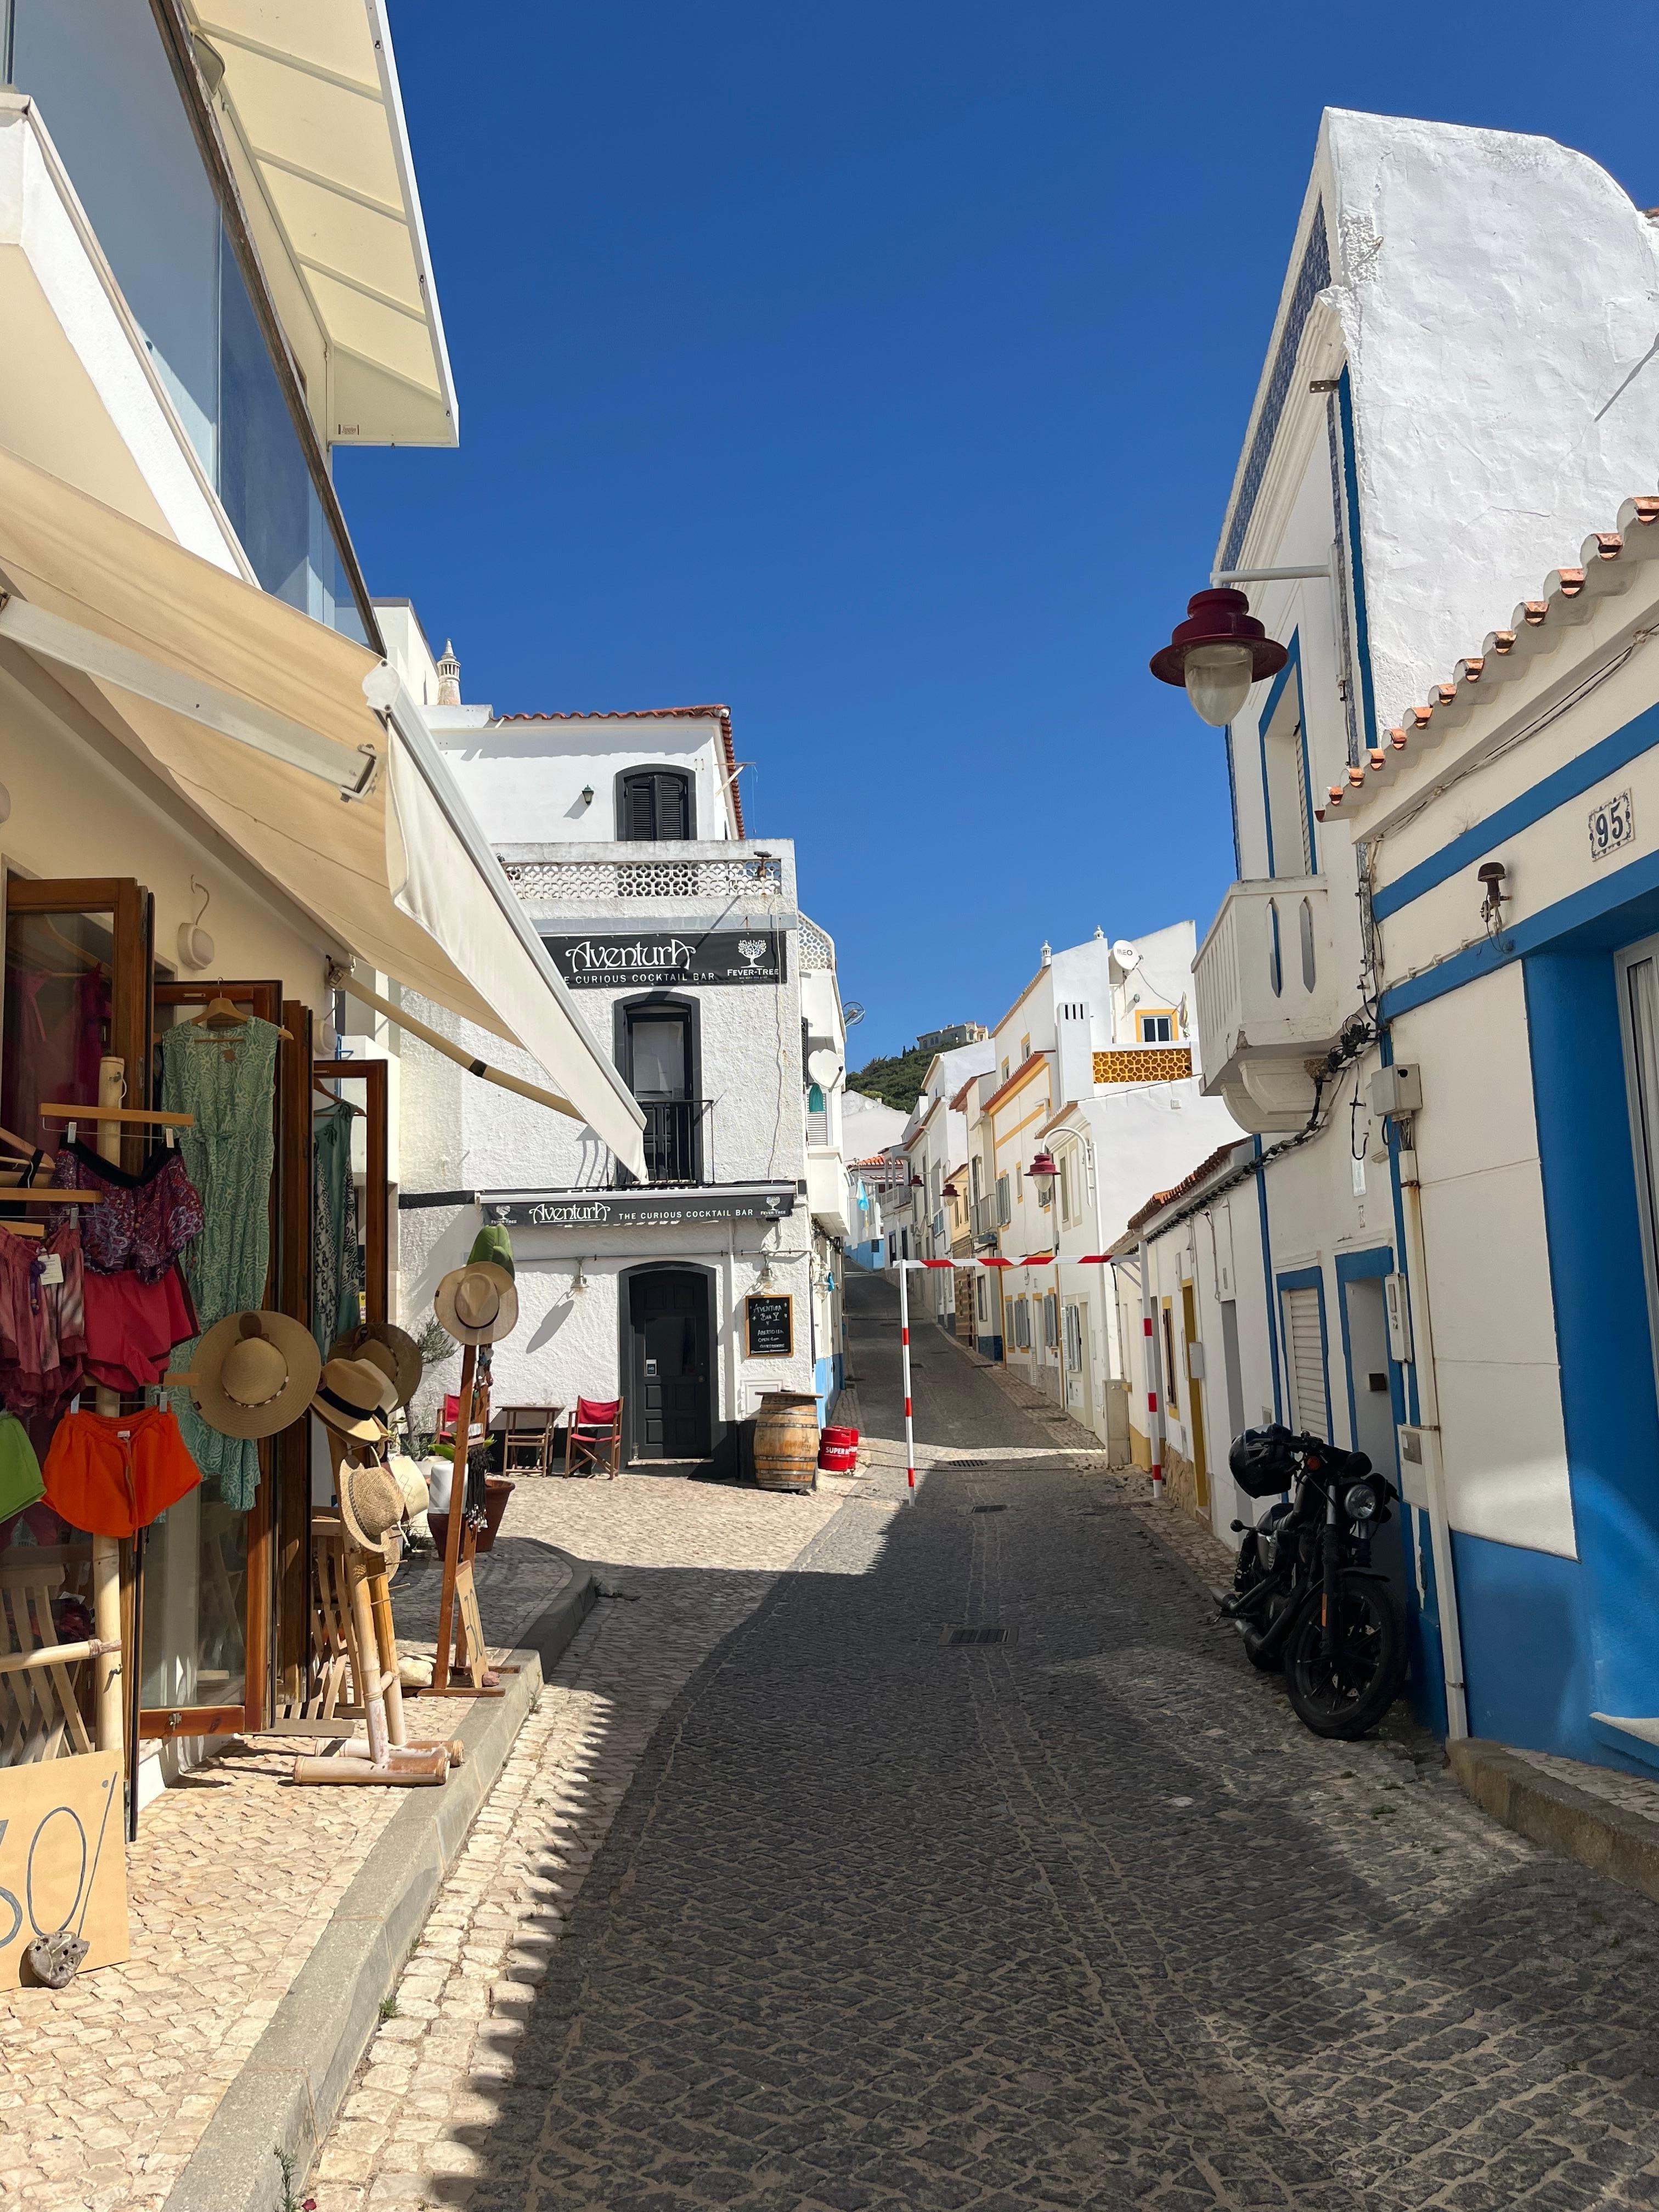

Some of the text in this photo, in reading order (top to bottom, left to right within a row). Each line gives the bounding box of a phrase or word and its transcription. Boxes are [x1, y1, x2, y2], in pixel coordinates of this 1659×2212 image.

[1596, 802, 1623, 848] 95
[576, 974, 627, 984] CURIOUS
[632, 973, 687, 982] COCKTAIL
[693, 972, 714, 981] BAR
[727, 968, 779, 977] FEVER-TREE
